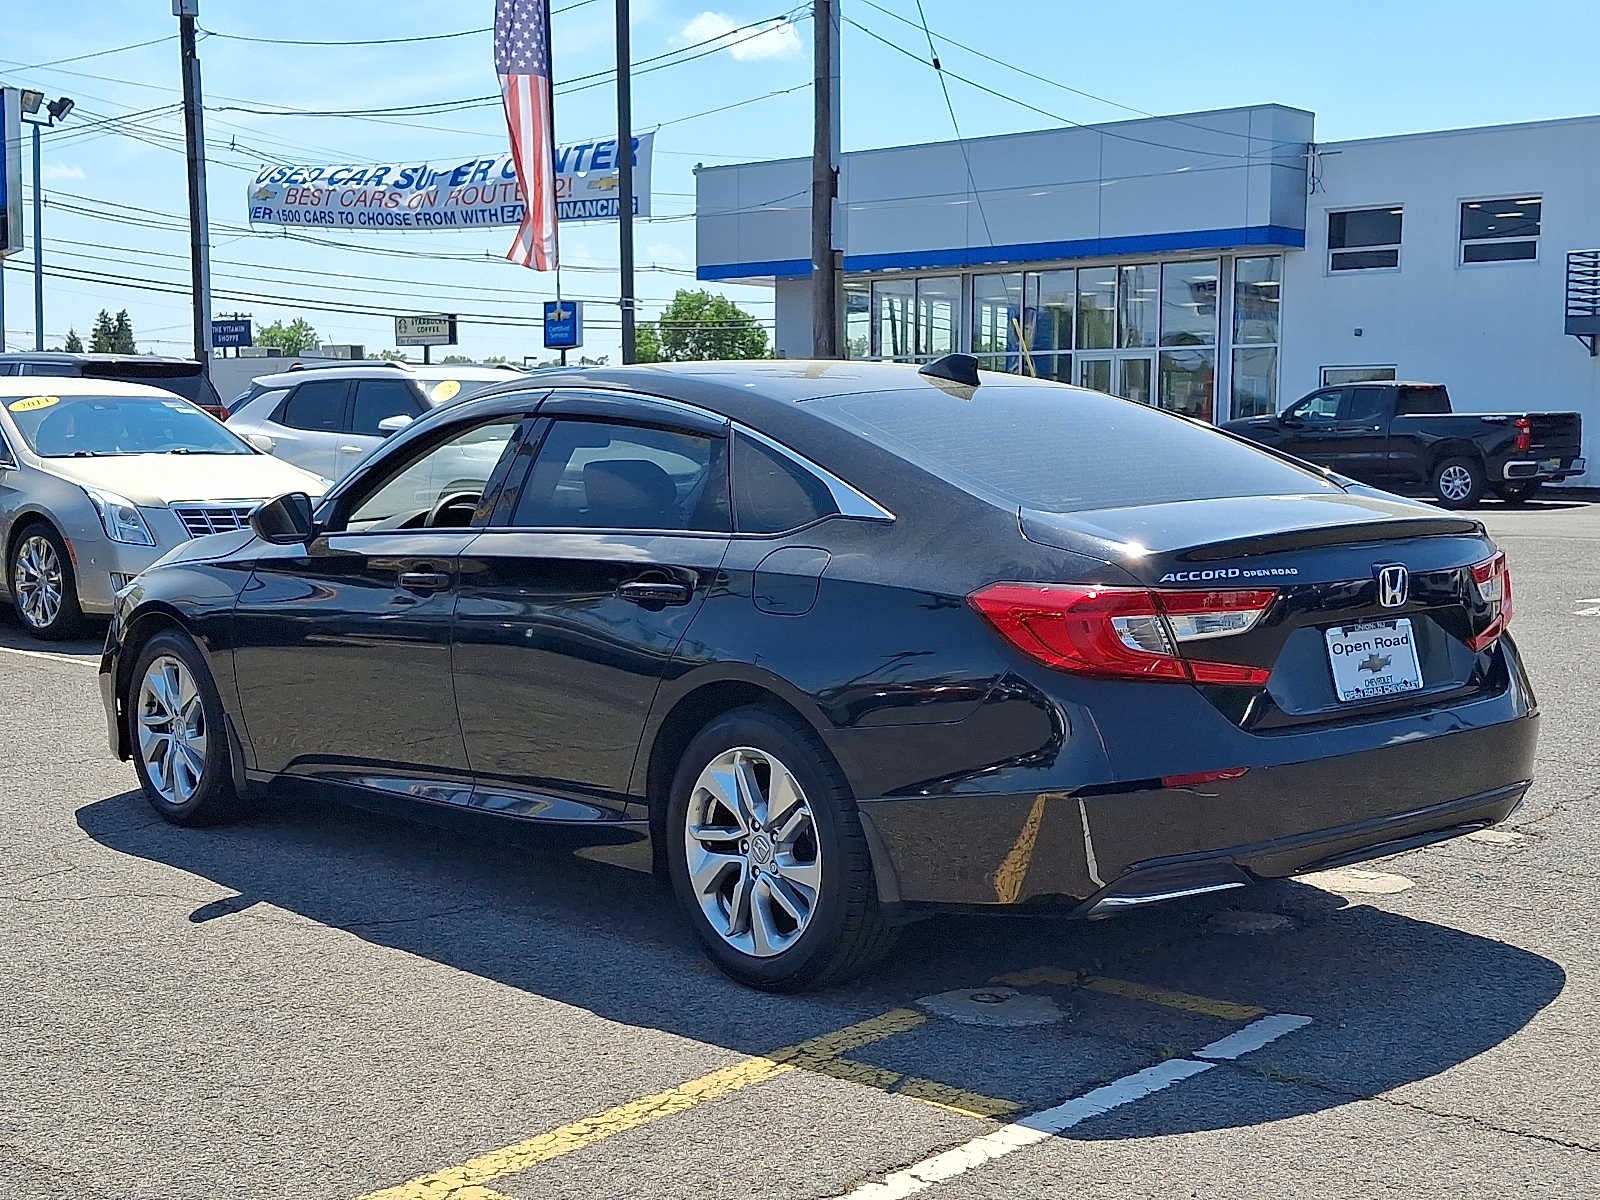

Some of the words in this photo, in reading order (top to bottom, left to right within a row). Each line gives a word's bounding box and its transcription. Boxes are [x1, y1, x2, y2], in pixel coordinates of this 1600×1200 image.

[255, 164, 325, 185] USED
[328, 166, 391, 186] CAR
[285, 187, 336, 207] BEST
[340, 189, 403, 209] CARS
[407, 190, 440, 212] ON
[444, 183, 525, 207] ROUTE
[276, 209, 301, 223] 1500
[304, 210, 335, 225] CARS
[338, 211, 354, 225] TO
[358, 212, 412, 226] CHOOSE
[414, 211, 458, 226] FROM
[463, 207, 498, 224] WITH
[1159, 568, 1240, 583] ACCORD
[1242, 569, 1270, 578] OPEN
[1271, 568, 1298, 576] ROAD
[1332, 641, 1371, 656] Open
[1374, 633, 1409, 649] Road
[1364, 687, 1384, 697] ROAD
